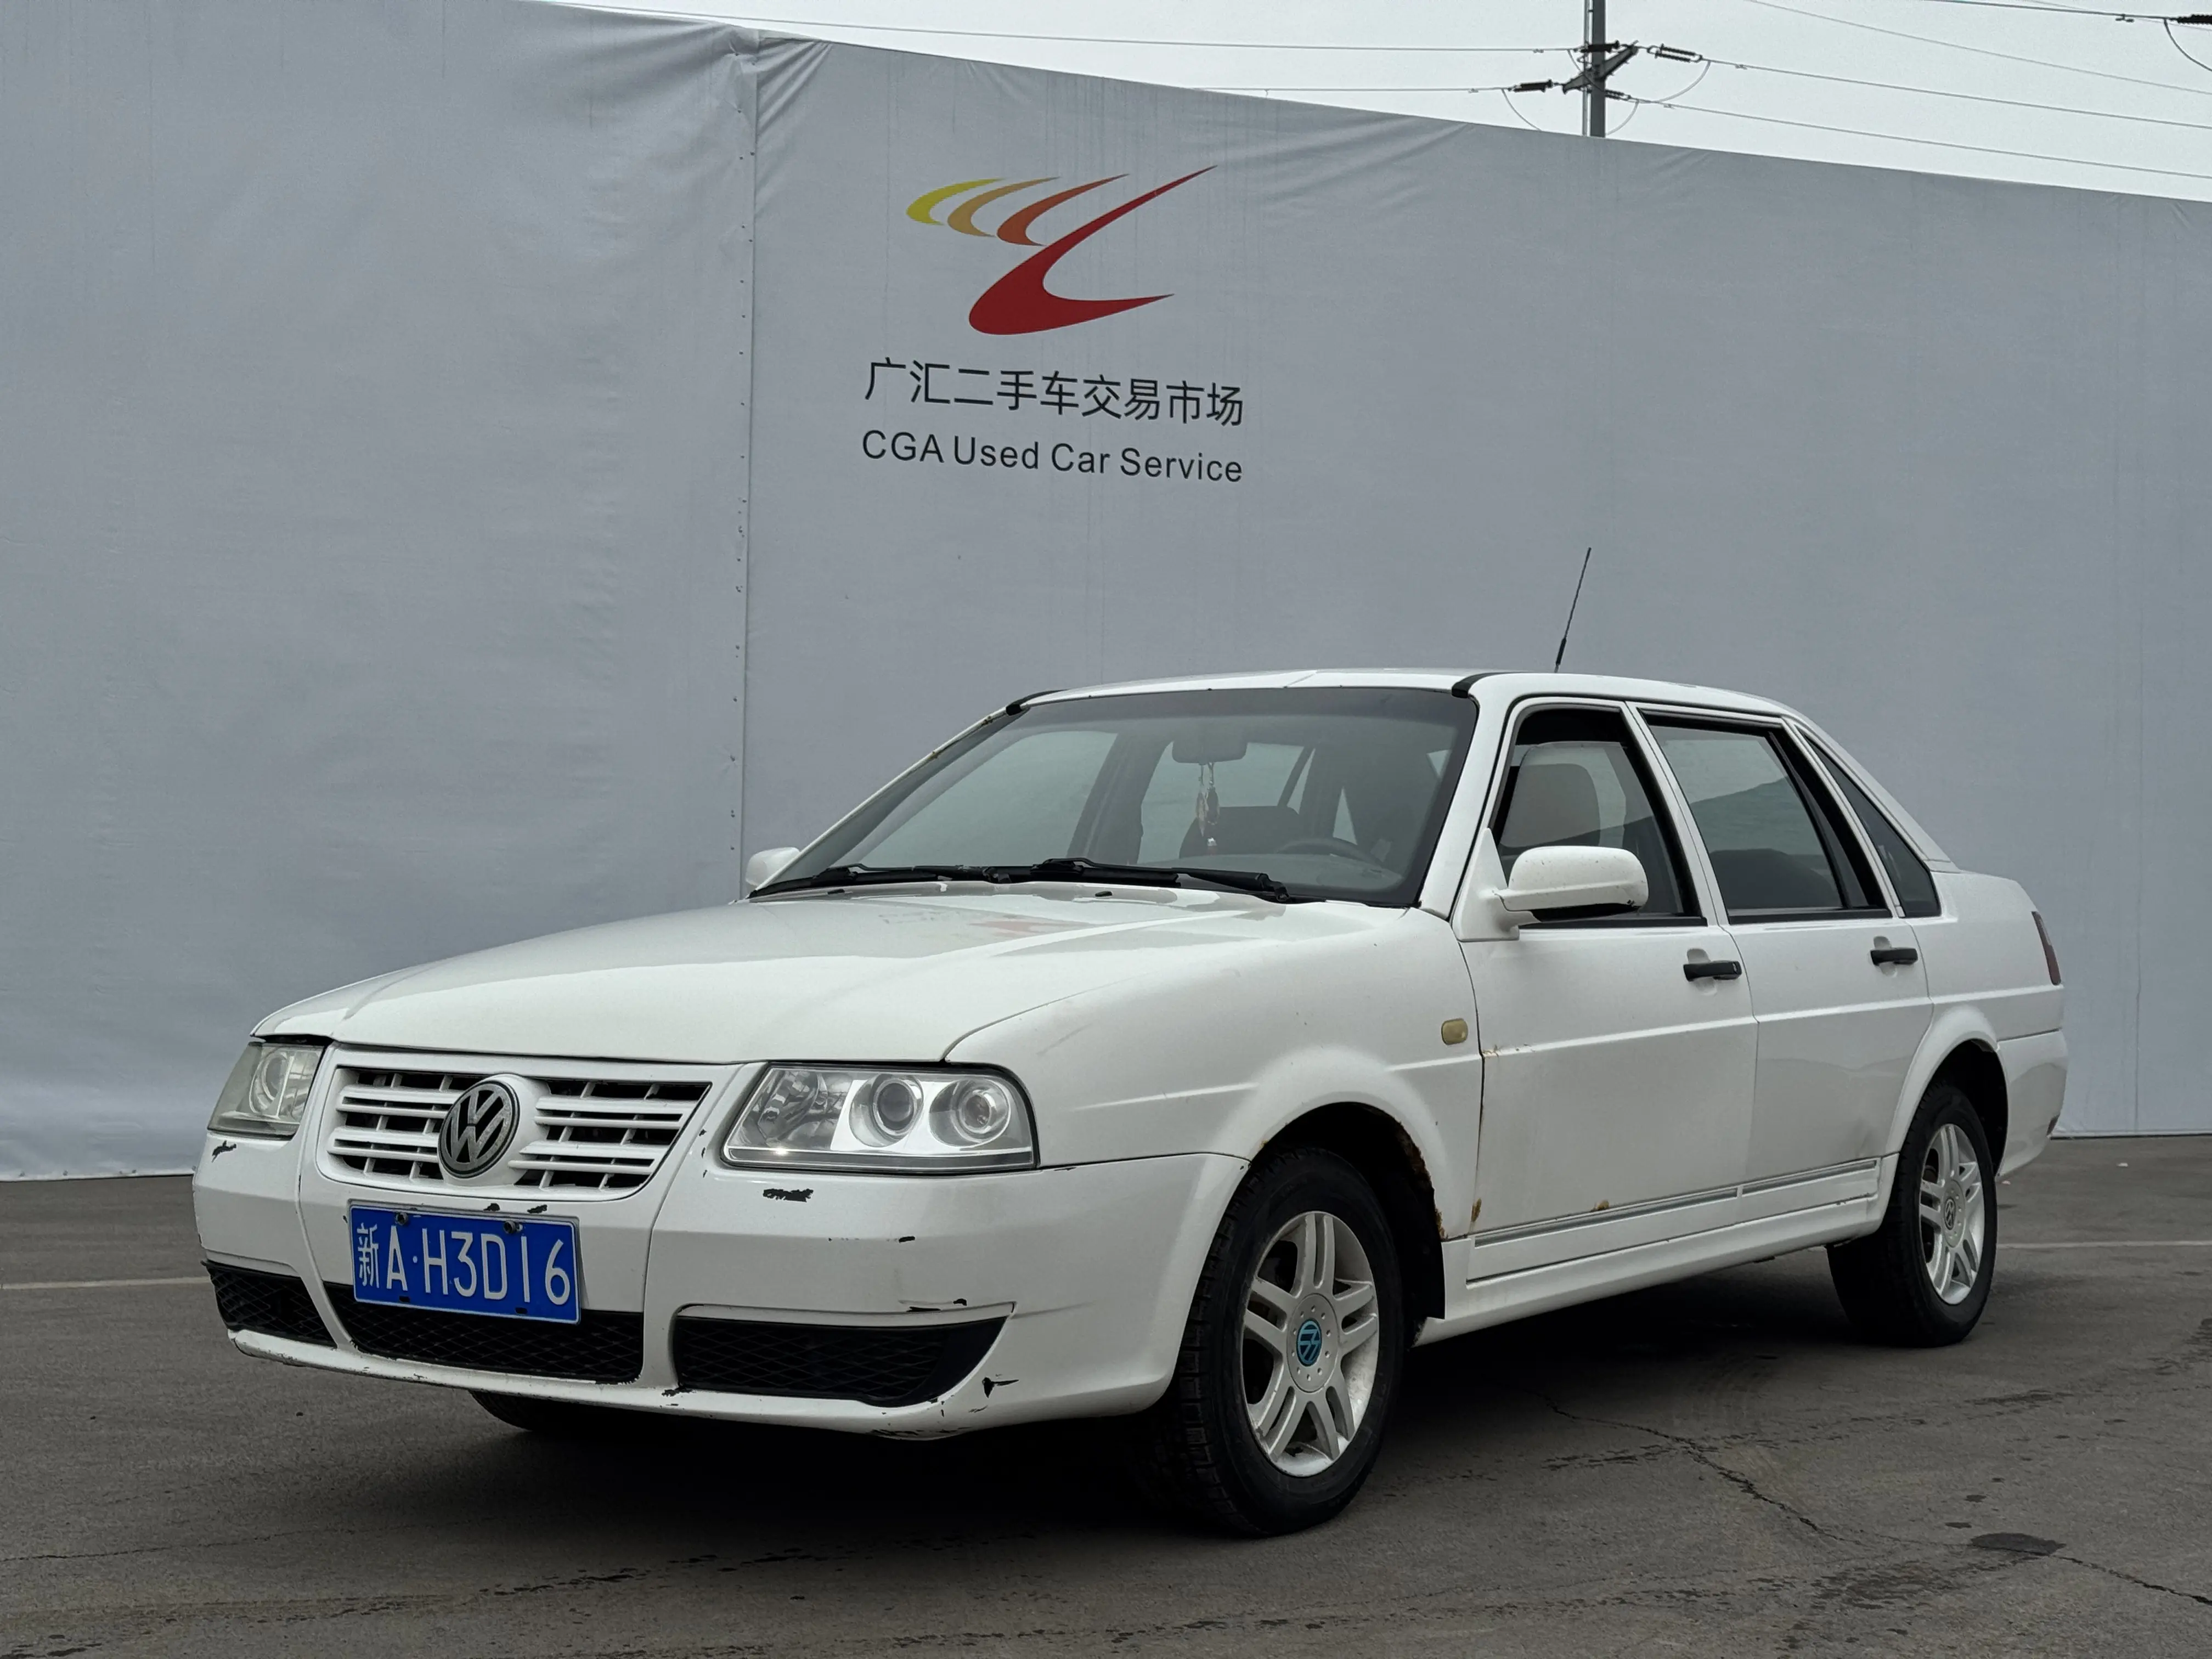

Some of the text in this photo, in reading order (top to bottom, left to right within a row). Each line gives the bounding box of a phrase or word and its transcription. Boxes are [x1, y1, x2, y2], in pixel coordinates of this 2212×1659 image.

[865, 357, 1243, 426] 广汇二手车交易市场
[862, 430, 1242, 482] CGA Used Car Service
[439, 1081, 512, 1177] VW
